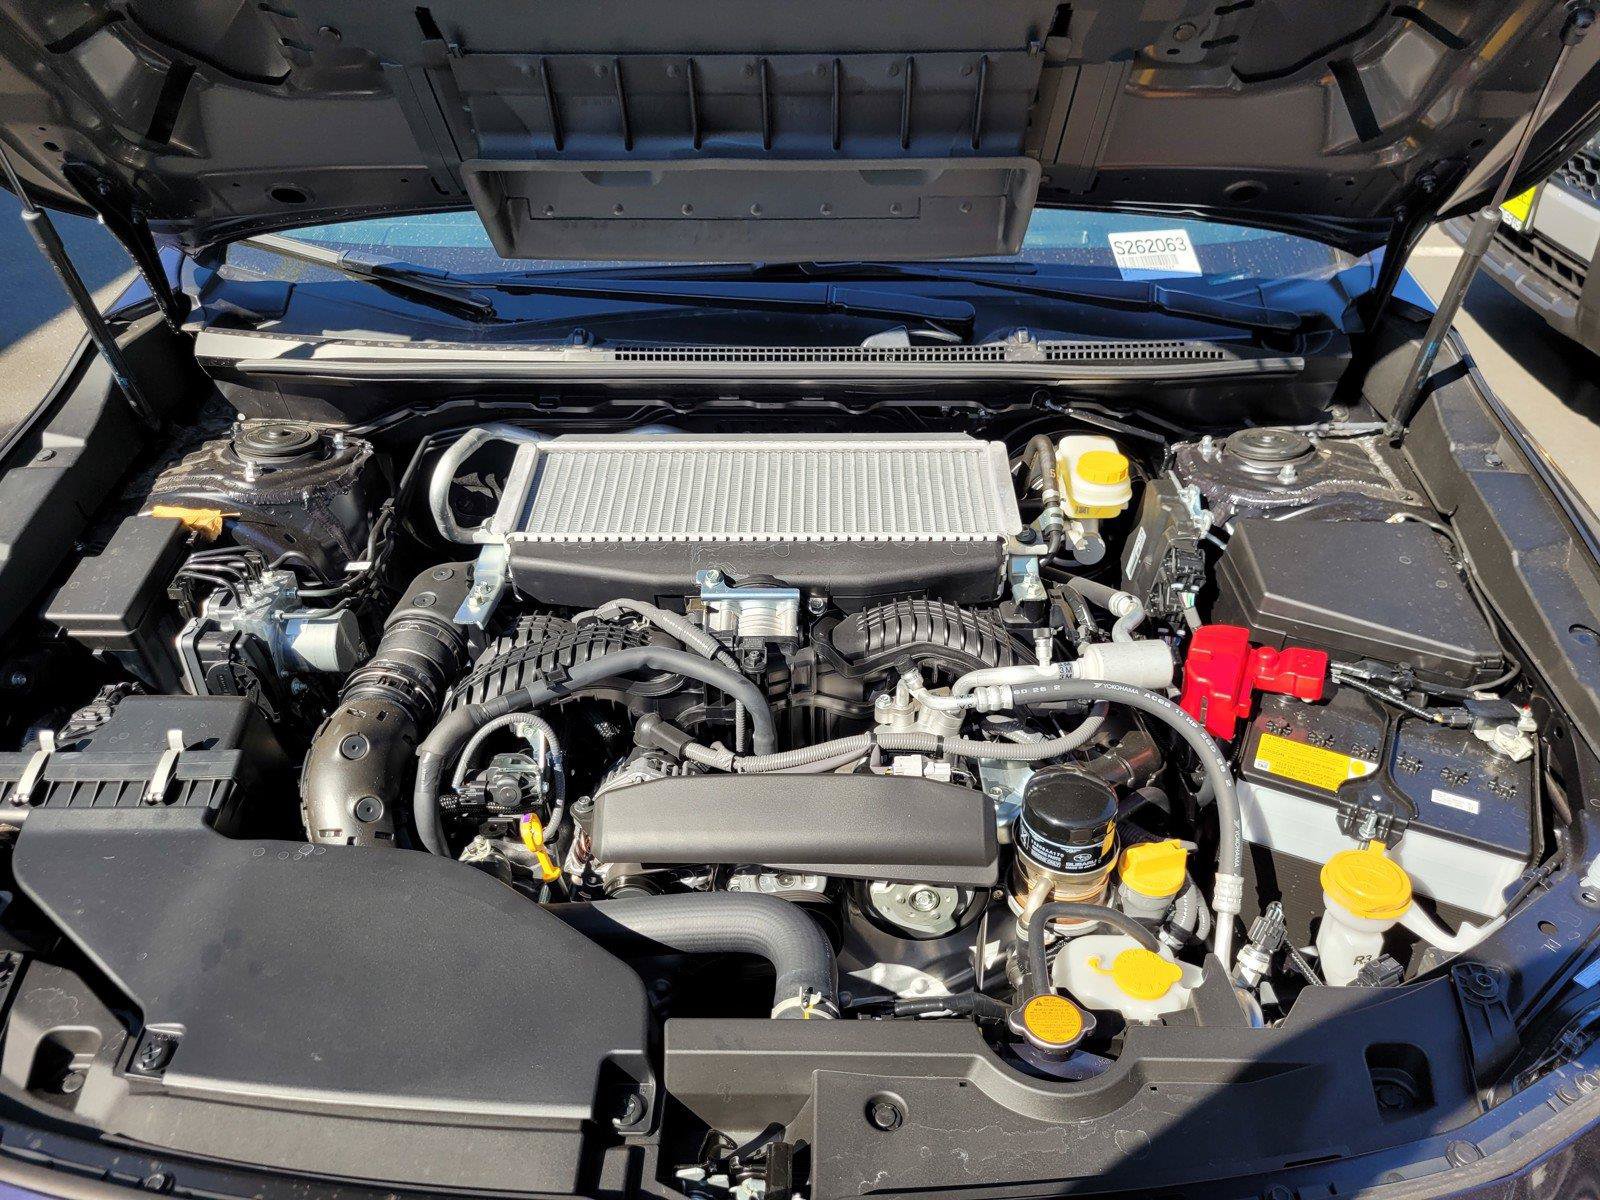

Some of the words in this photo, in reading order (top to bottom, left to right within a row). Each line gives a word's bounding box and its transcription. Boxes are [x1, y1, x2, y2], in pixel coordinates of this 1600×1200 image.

[1113, 237, 1187, 255] S262063
[1103, 683, 1139, 695] YOKOHAMA
[1065, 859, 1097, 867] SUBARU
